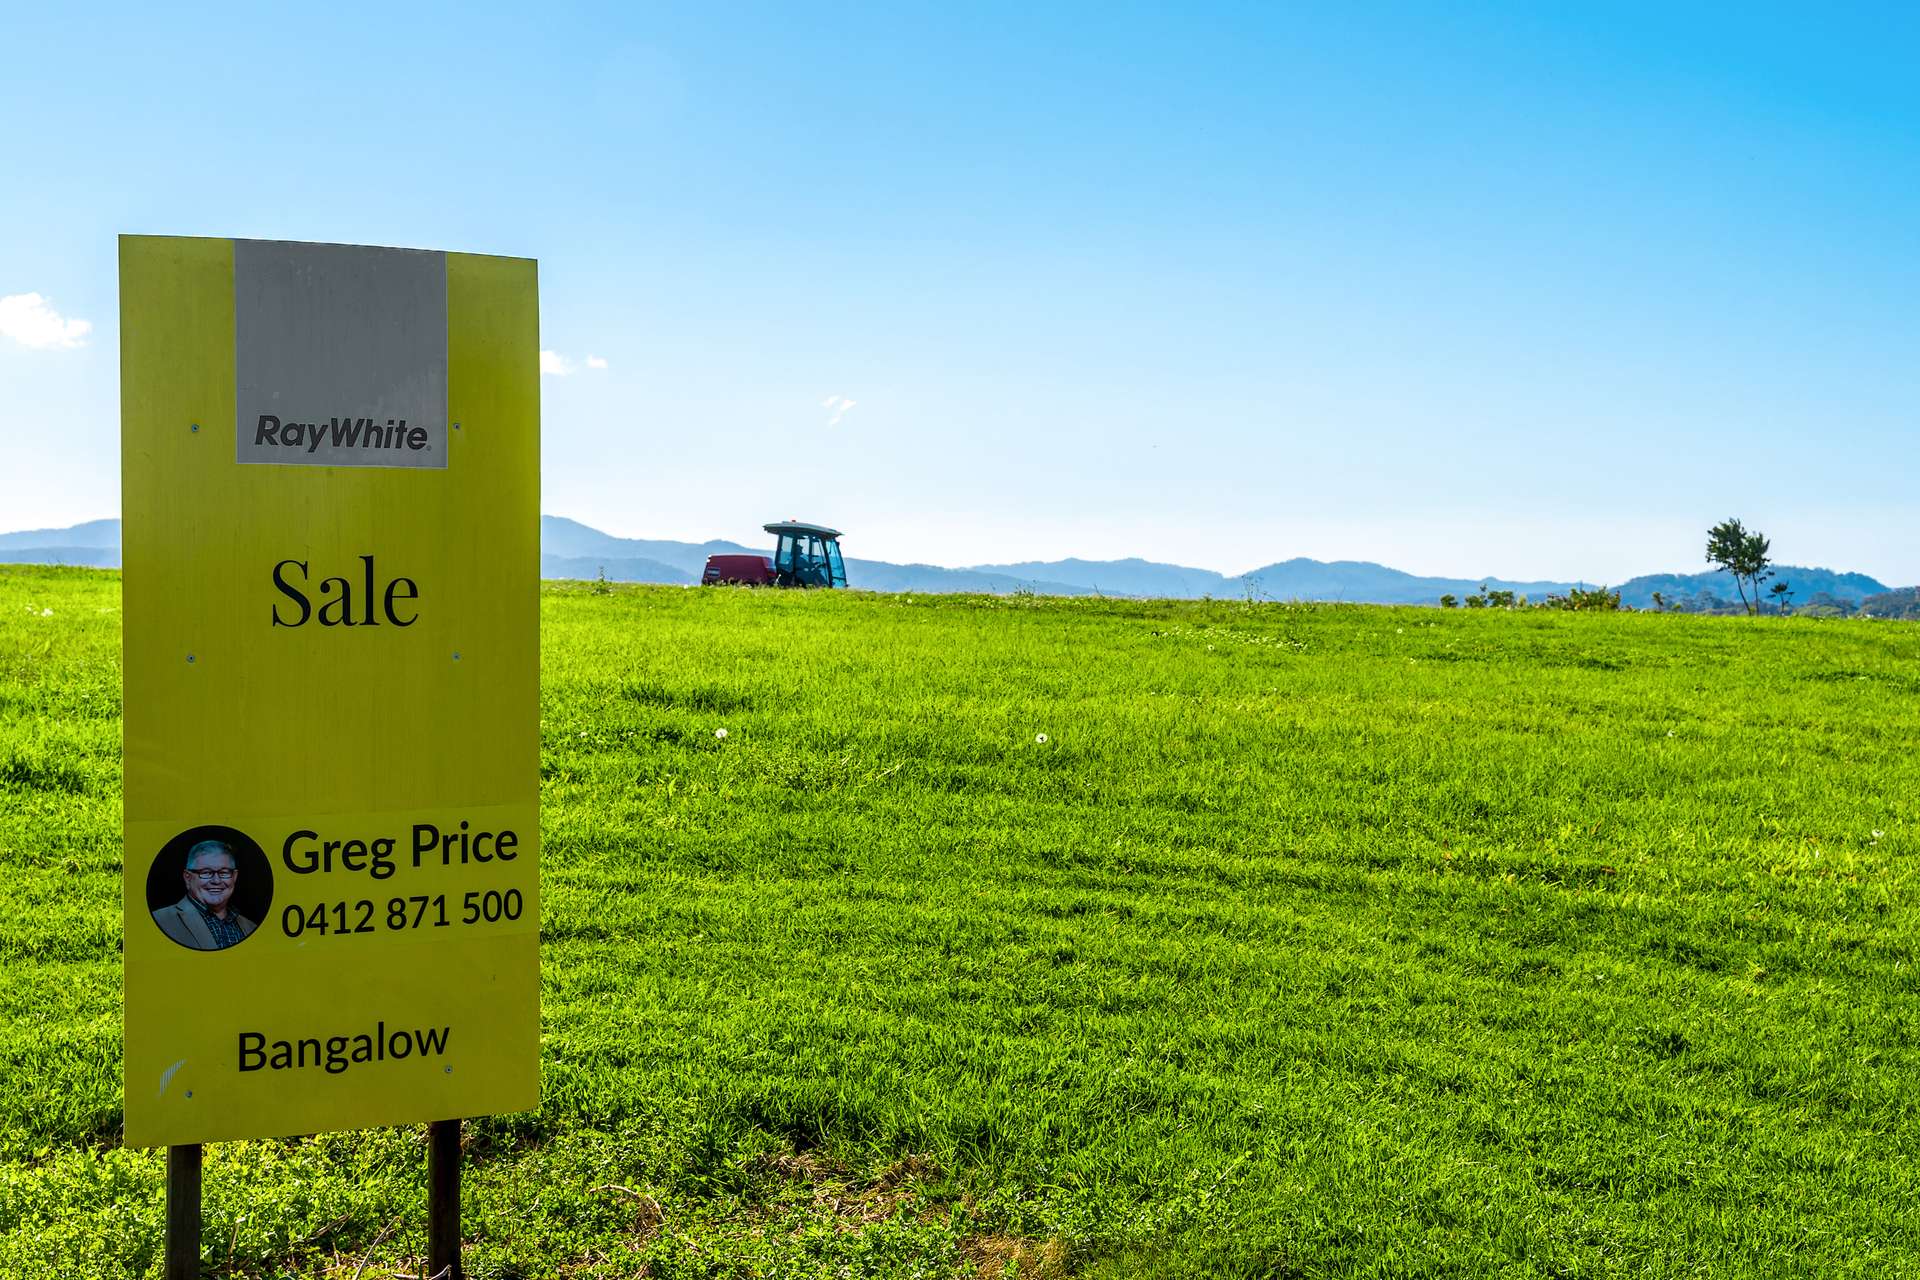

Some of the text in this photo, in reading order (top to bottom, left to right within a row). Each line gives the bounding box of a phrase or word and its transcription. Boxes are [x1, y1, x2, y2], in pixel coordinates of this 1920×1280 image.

[272, 555, 419, 627] Sale
[282, 821, 518, 880] Greg Price
[282, 888, 523, 938] 0412 871 500
[238, 1021, 450, 1074] Bangalow
